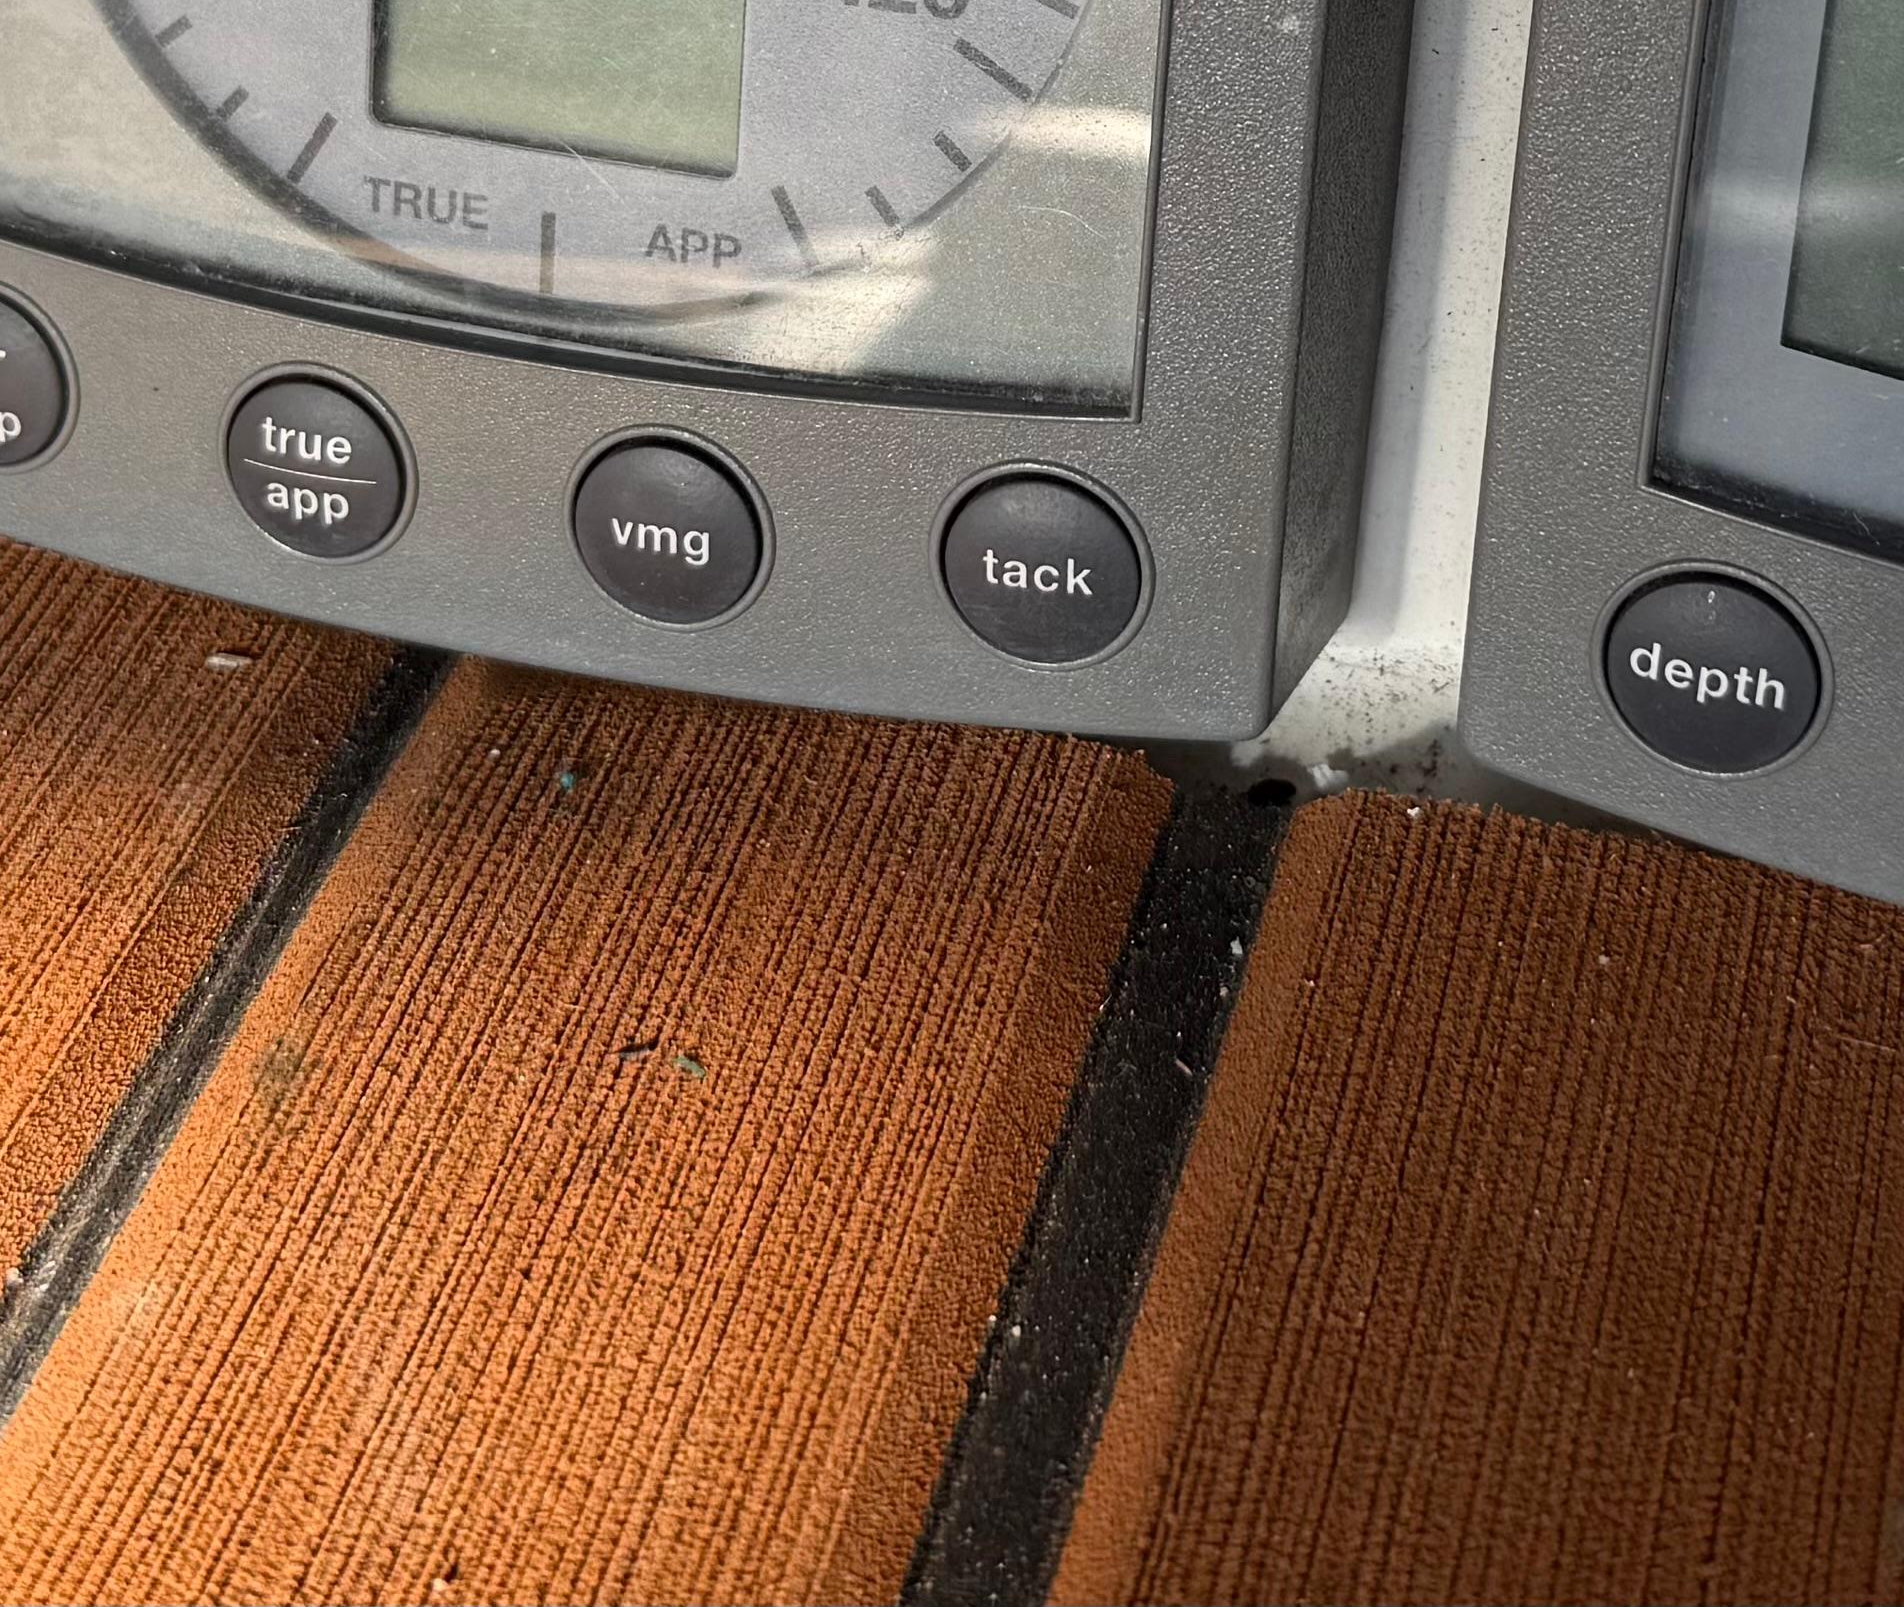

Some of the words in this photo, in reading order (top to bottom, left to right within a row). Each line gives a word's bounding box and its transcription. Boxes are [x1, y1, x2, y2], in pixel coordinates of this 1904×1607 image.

[364, 175, 489, 230] TRUE
[644, 223, 743, 269] APP
[262, 416, 353, 465] true
[266, 481, 350, 526] app
[611, 517, 710, 566] vmg
[983, 548, 1093, 595] tack
[1629, 642, 1787, 710] depth
